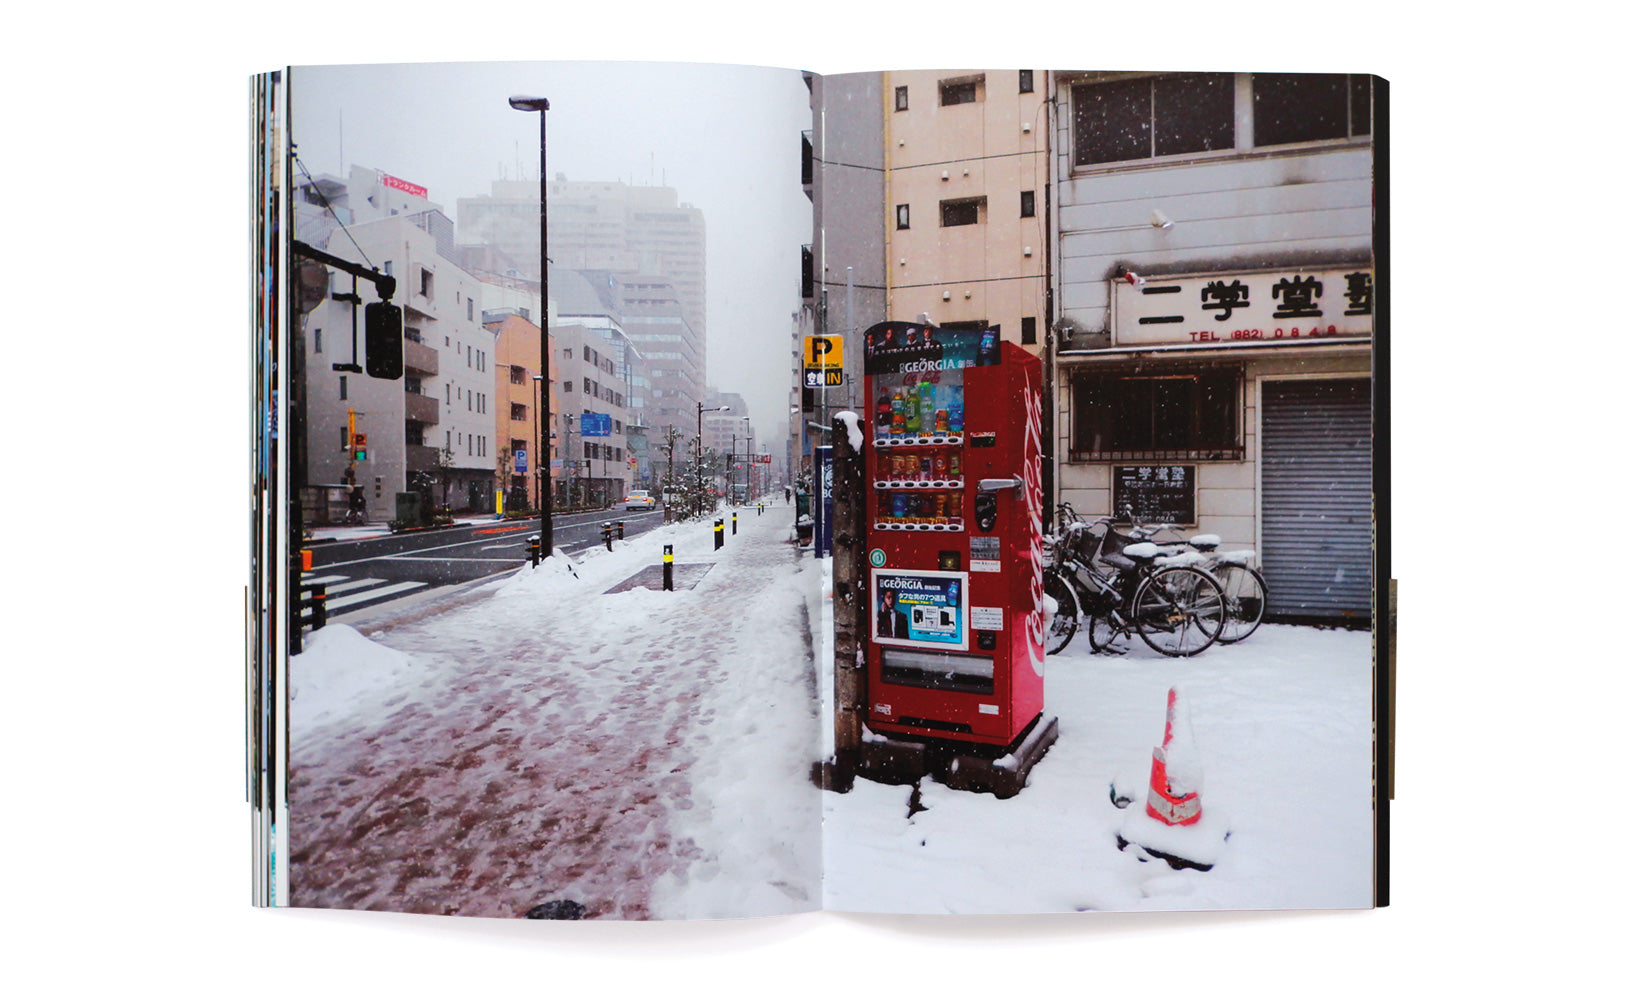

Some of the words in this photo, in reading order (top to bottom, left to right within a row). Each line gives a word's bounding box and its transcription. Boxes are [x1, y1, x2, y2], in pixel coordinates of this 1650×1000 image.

[1231, 329, 1263, 340] (882)
[812, 338, 833, 362] P
[827, 372, 841, 385] IN
[518, 451, 525, 460] P
